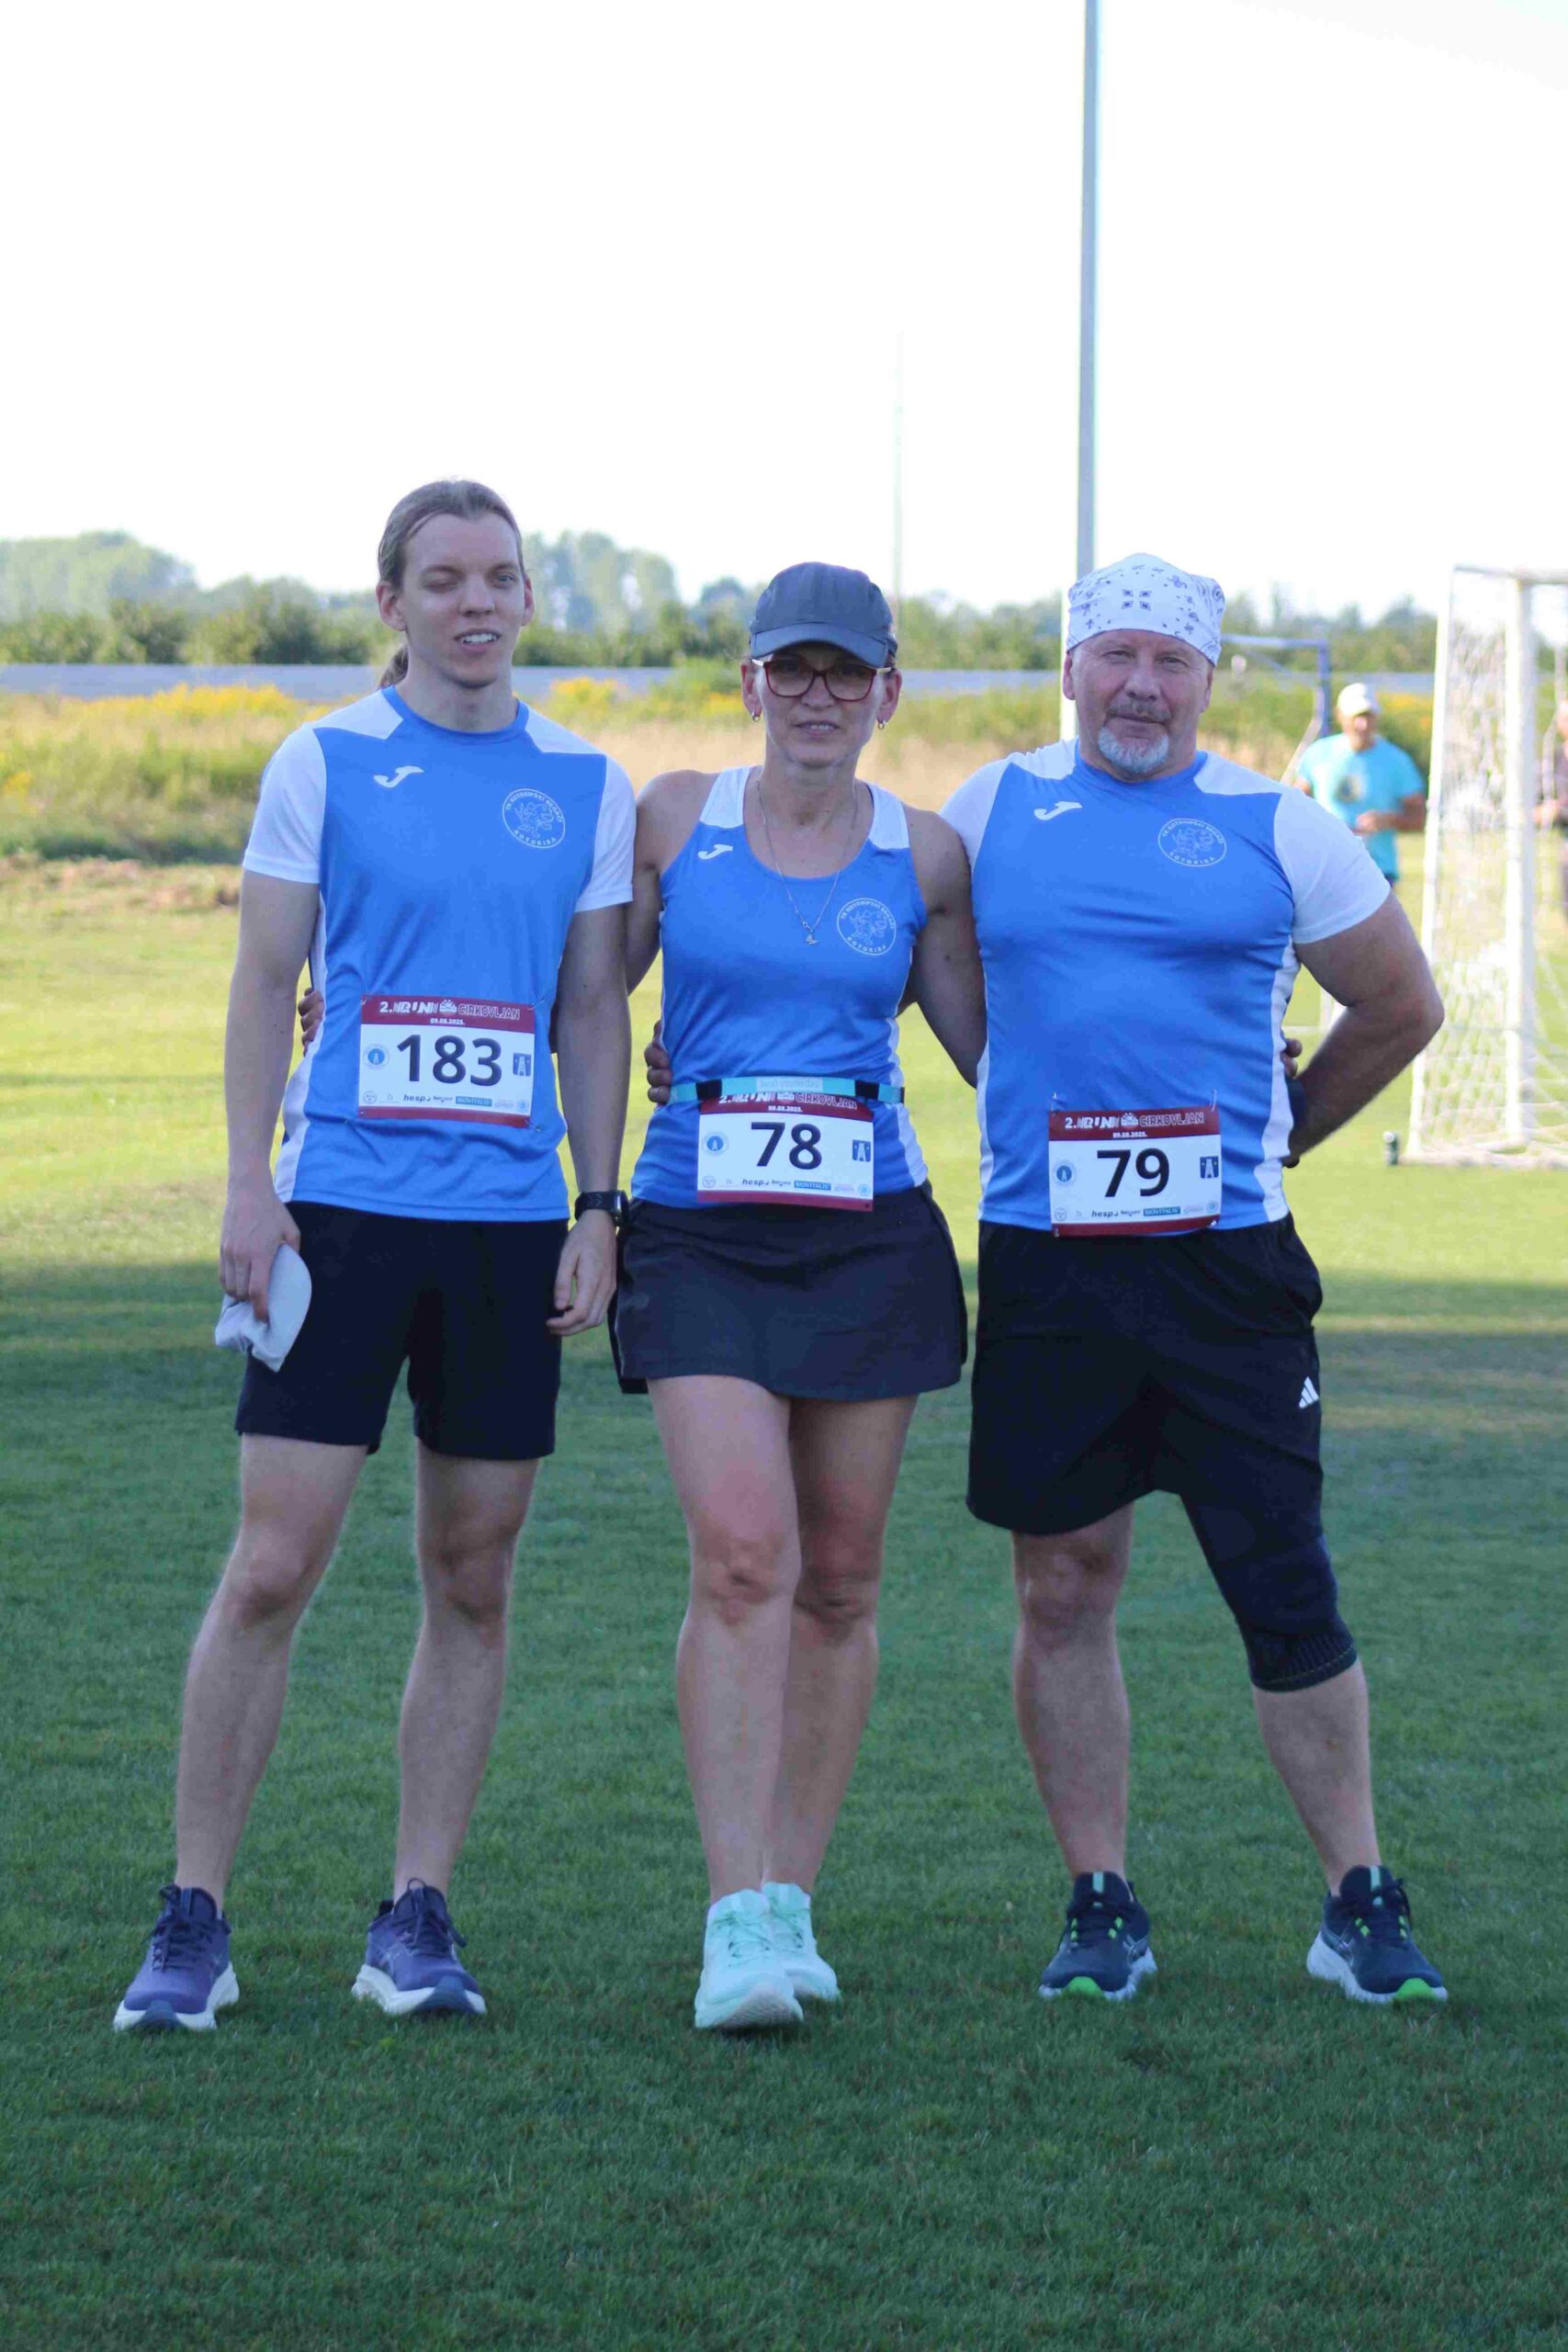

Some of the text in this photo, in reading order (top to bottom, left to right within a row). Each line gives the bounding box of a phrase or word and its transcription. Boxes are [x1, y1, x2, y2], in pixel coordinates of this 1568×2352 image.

[458, 1003, 521, 1021] CIRKOVLJAN
[397, 1034, 502, 1087] 183
[795, 1092, 858, 1110] CIRKOVLJAN
[1139, 1112, 1205, 1127] CIRKOVLJAN
[750, 1121, 822, 1170] 78
[1097, 1148, 1170, 1198] 79
